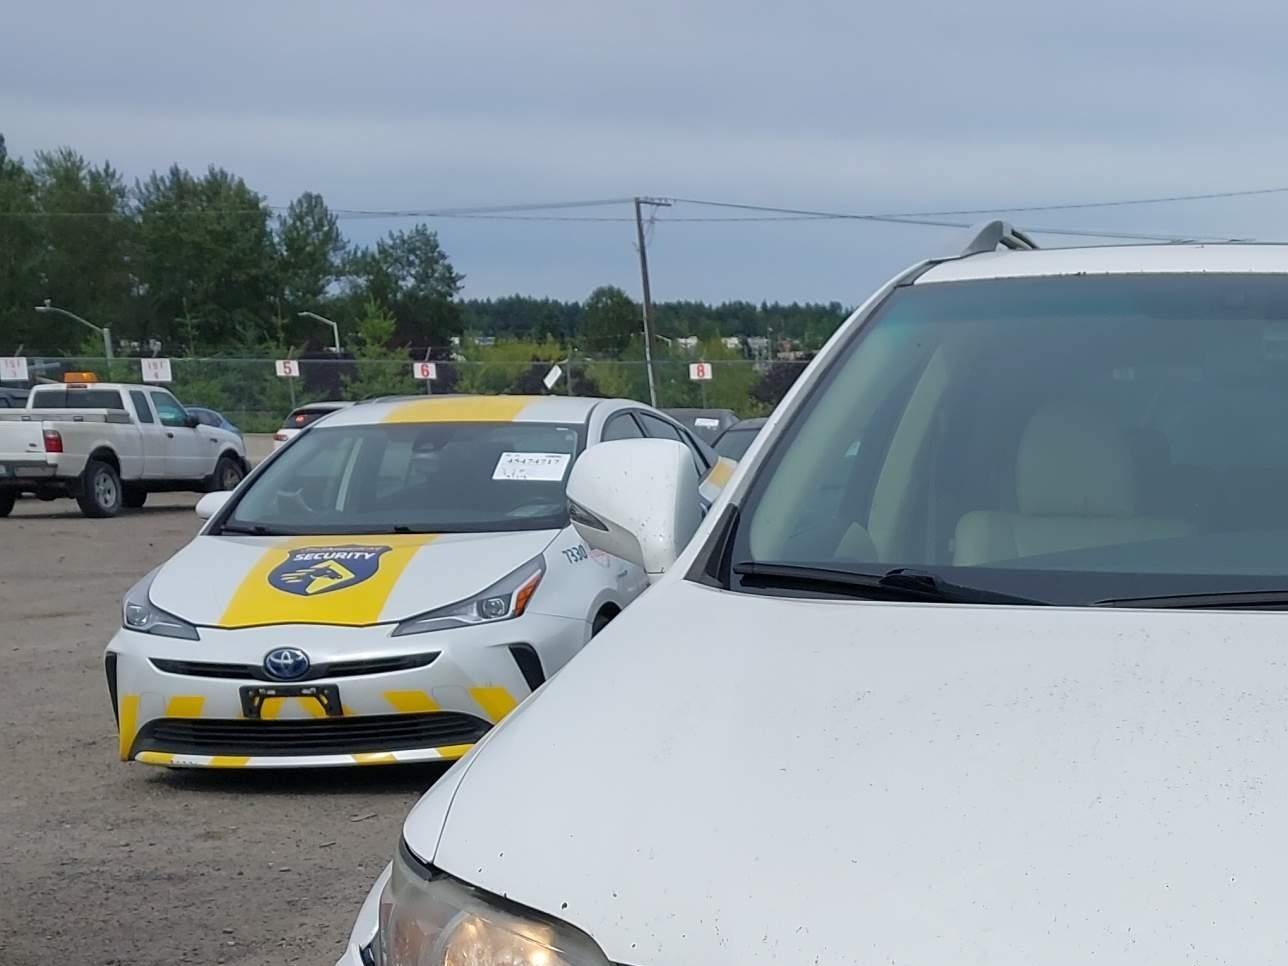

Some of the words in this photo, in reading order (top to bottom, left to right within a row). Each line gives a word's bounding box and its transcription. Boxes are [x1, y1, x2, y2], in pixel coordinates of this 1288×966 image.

[283, 361, 292, 375] 5
[420, 364, 430, 378] 6
[697, 364, 705, 377] 8
[293, 551, 377, 561] SECURITY
